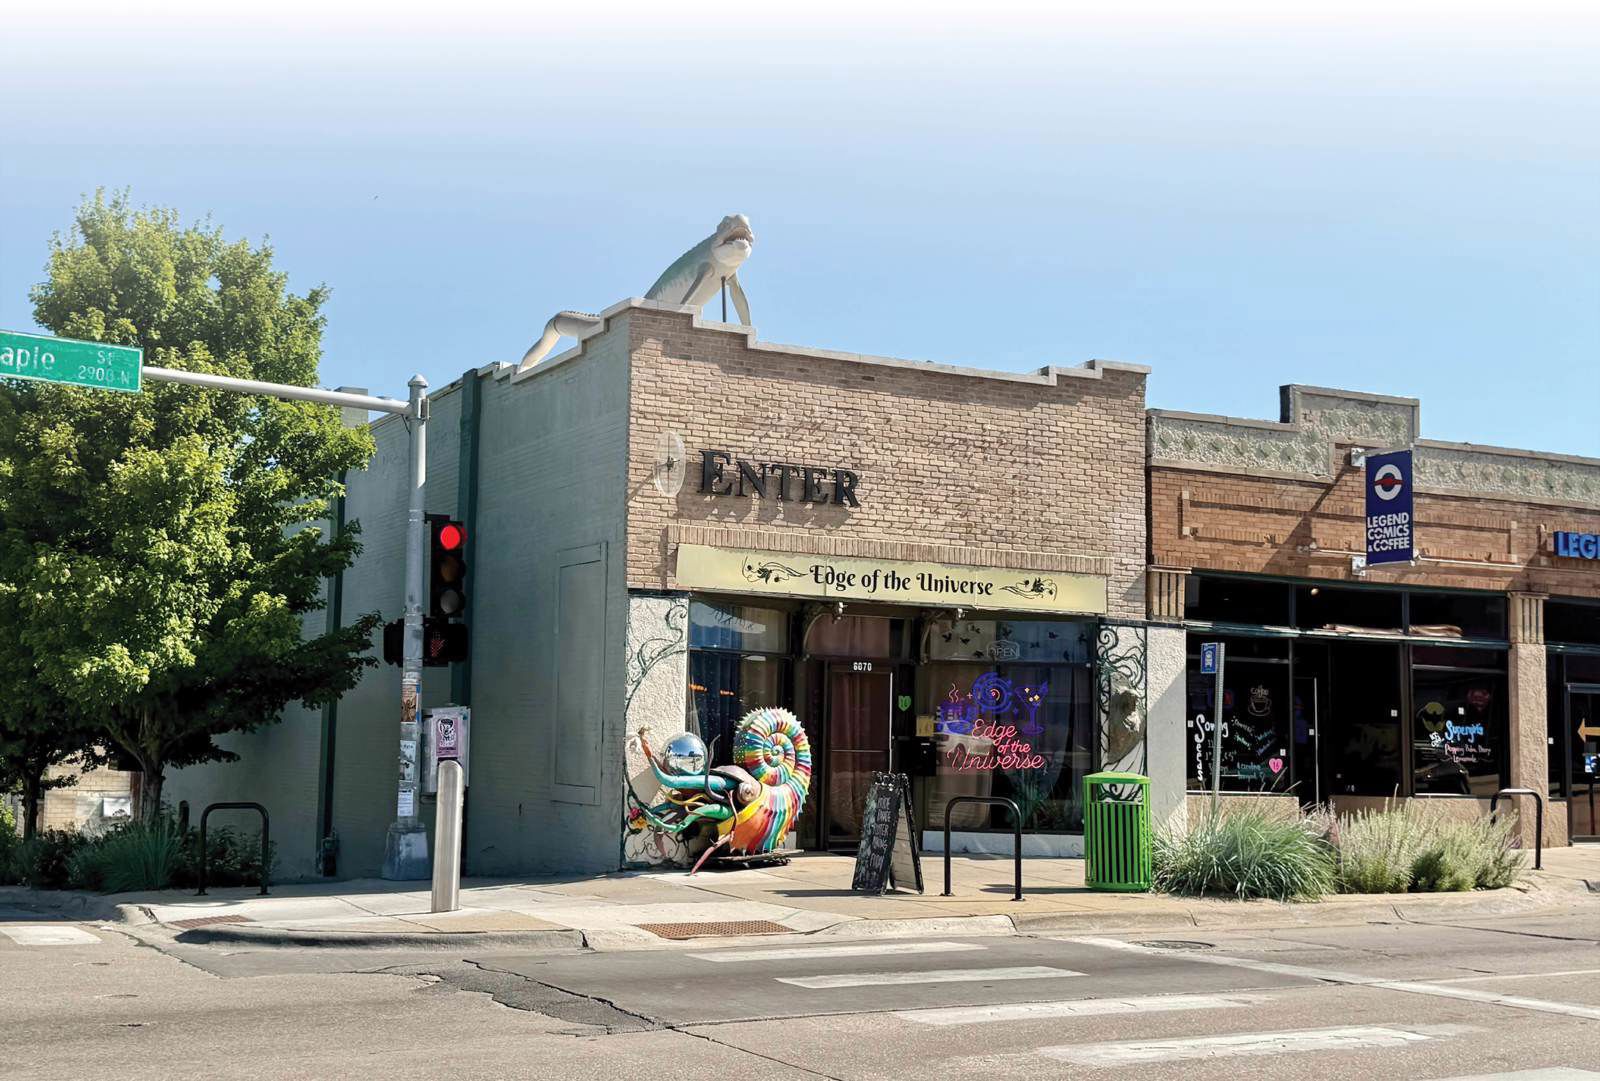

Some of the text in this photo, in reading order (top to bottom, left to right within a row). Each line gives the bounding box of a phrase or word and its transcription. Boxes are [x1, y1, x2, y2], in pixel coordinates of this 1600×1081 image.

[97, 350, 113, 366] St
[78, 365, 130, 385] 2900 N
[1367, 512, 1410, 528] LEGEND
[1367, 524, 1410, 540] COMICS
[1373, 537, 1410, 552] COFFEE
[809, 564, 994, 596] Edge of the Universe
[989, 647, 1018, 657] OPEN
[971, 718, 1018, 745] Edge
[997, 739, 1031, 754] of the
[946, 745, 1045, 771] Universe
